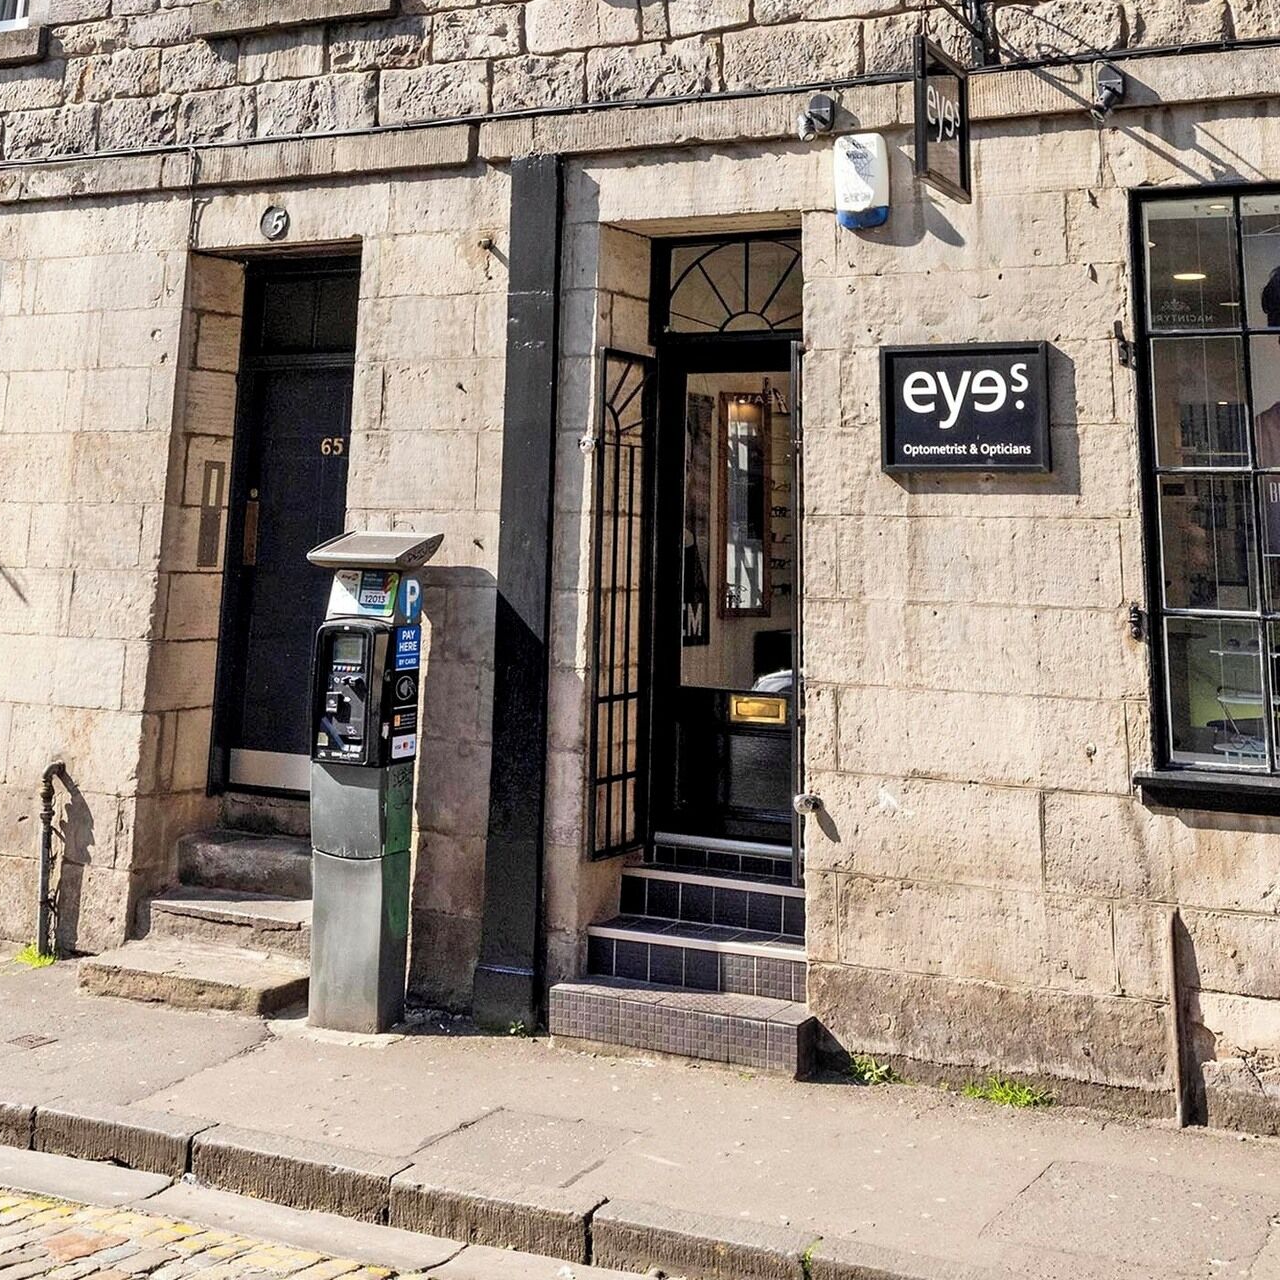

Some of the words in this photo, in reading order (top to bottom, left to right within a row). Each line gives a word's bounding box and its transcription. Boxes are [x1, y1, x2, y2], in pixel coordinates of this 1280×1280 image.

[321, 437, 344, 456] 65
[903, 443, 967, 457] Optometrist
[969, 444, 978, 455] &
[980, 443, 1032, 457] Opticians
[363, 594, 387, 604] 12013
[402, 630, 416, 640] PAY
[399, 641, 418, 652] HERE
